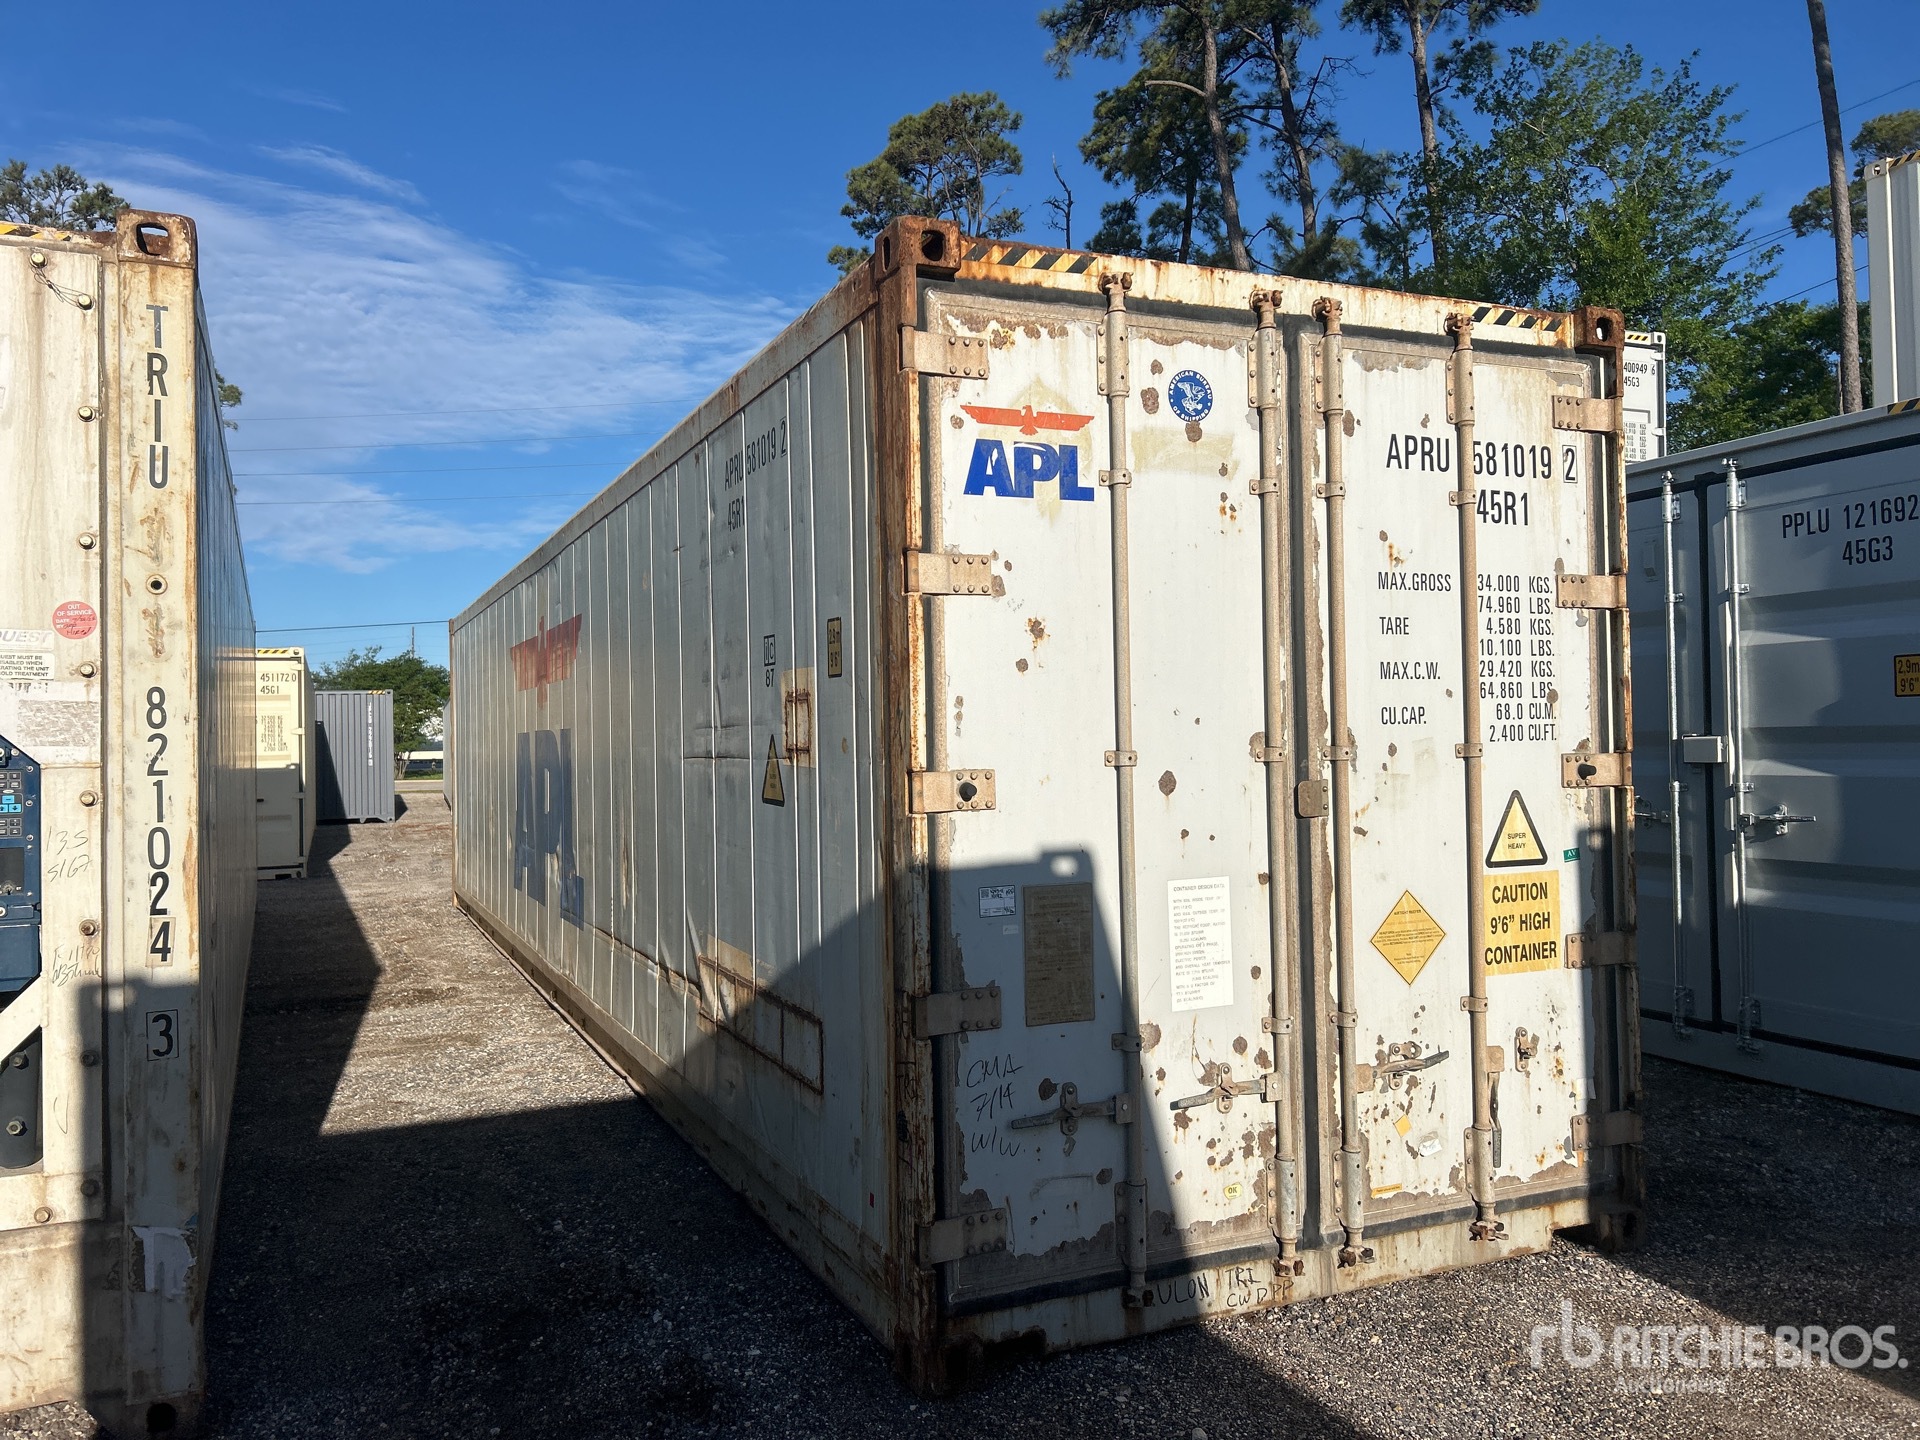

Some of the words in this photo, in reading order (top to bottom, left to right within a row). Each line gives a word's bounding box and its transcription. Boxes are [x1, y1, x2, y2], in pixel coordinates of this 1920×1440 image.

[1623, 362, 1648, 374] 400949
[1169, 371, 1194, 395] AMERICAN
[1623, 376, 1640, 387] 45G3
[146, 305, 168, 488] TRIU
[725, 450, 744, 491] APRU
[747, 427, 776, 475] 581019
[1386, 434, 1450, 472] APRU
[1473, 440, 1552, 479] 581019
[1564, 447, 1576, 481] 2
[963, 438, 1095, 501] APL
[728, 495, 745, 532] 45R1
[1477, 489, 1529, 525] 45R1
[1782, 508, 1830, 538] PPLU
[1843, 494, 1920, 529] 121692
[1842, 535, 1894, 565] 45G3
[1378, 571, 1452, 592] MAX.GROSS
[1477, 574, 1520, 592] 34,000
[1529, 576, 1553, 594] KGS.
[1478, 595, 1521, 613] 74,960
[1529, 597, 1554, 615] LBS.
[1379, 616, 1410, 635] TARE
[1486, 617, 1521, 635] 4,580
[1530, 618, 1555, 636] KGS.
[0, 631, 52, 643] UEST
[1480, 638, 1522, 656] 10,100
[1530, 639, 1555, 657] LBS.
[260, 673, 290, 682] 451172
[765, 669, 775, 687] 87
[1380, 661, 1441, 680] MAX.C.W.
[1479, 660, 1522, 678] 29,420
[1531, 660, 1556, 677] KGS.
[260, 685, 280, 694] 45G1
[1480, 681, 1523, 699] 64,860
[1381, 706, 1427, 725] CU.CAP.
[1496, 703, 1523, 720] 68.0
[1529, 703, 1557, 720] CU.M.
[1489, 724, 1524, 742] 2,400
[1528, 723, 1557, 741] CU.FT.
[146, 686, 172, 962] 821024
[1507, 832, 1527, 840] SUPER
[1492, 882, 1548, 904] CAUTION
[1519, 911, 1551, 931] HIGH
[1484, 940, 1557, 966] CONTAINER
[151, 1013, 174, 1057] 3
[966, 1054, 1023, 1088] CMA
[1227, 1186, 1238, 1194] OK
